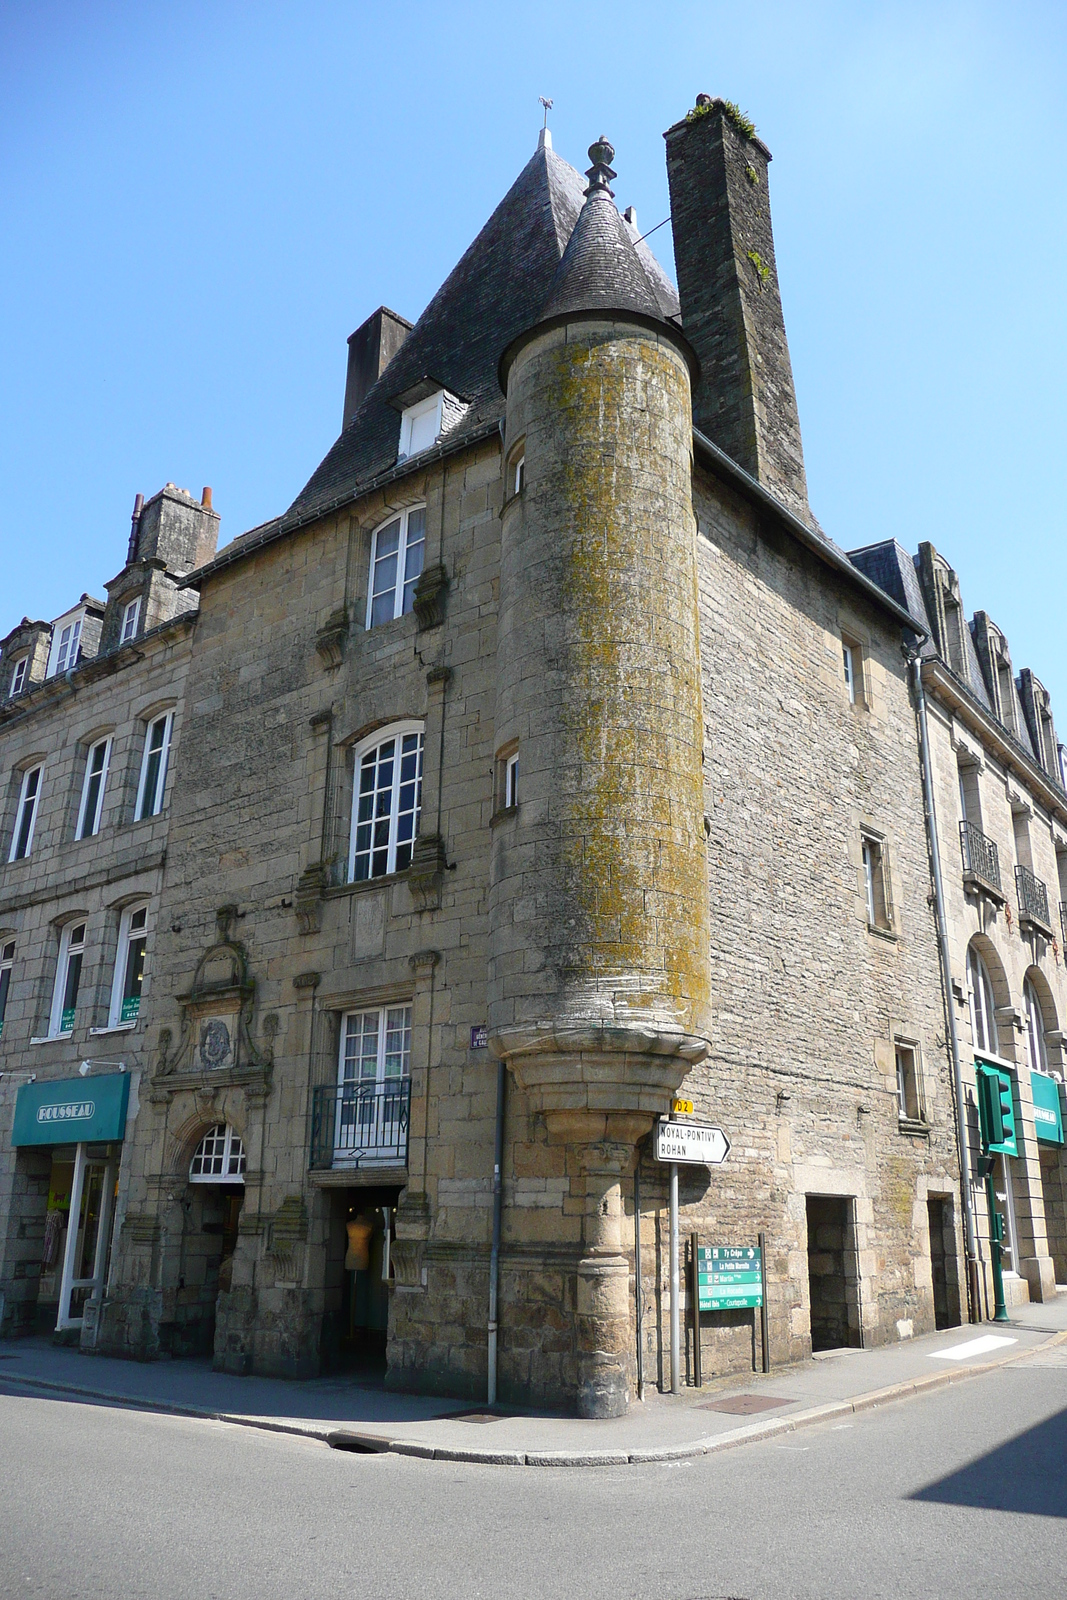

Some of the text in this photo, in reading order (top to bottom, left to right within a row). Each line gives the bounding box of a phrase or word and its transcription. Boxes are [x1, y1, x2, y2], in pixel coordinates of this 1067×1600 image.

[38, 1104, 93, 1120] ROUSSEAU
[660, 1126, 716, 1142] NOYAL-PONTIVY
[661, 1143, 686, 1155] ROHAN
